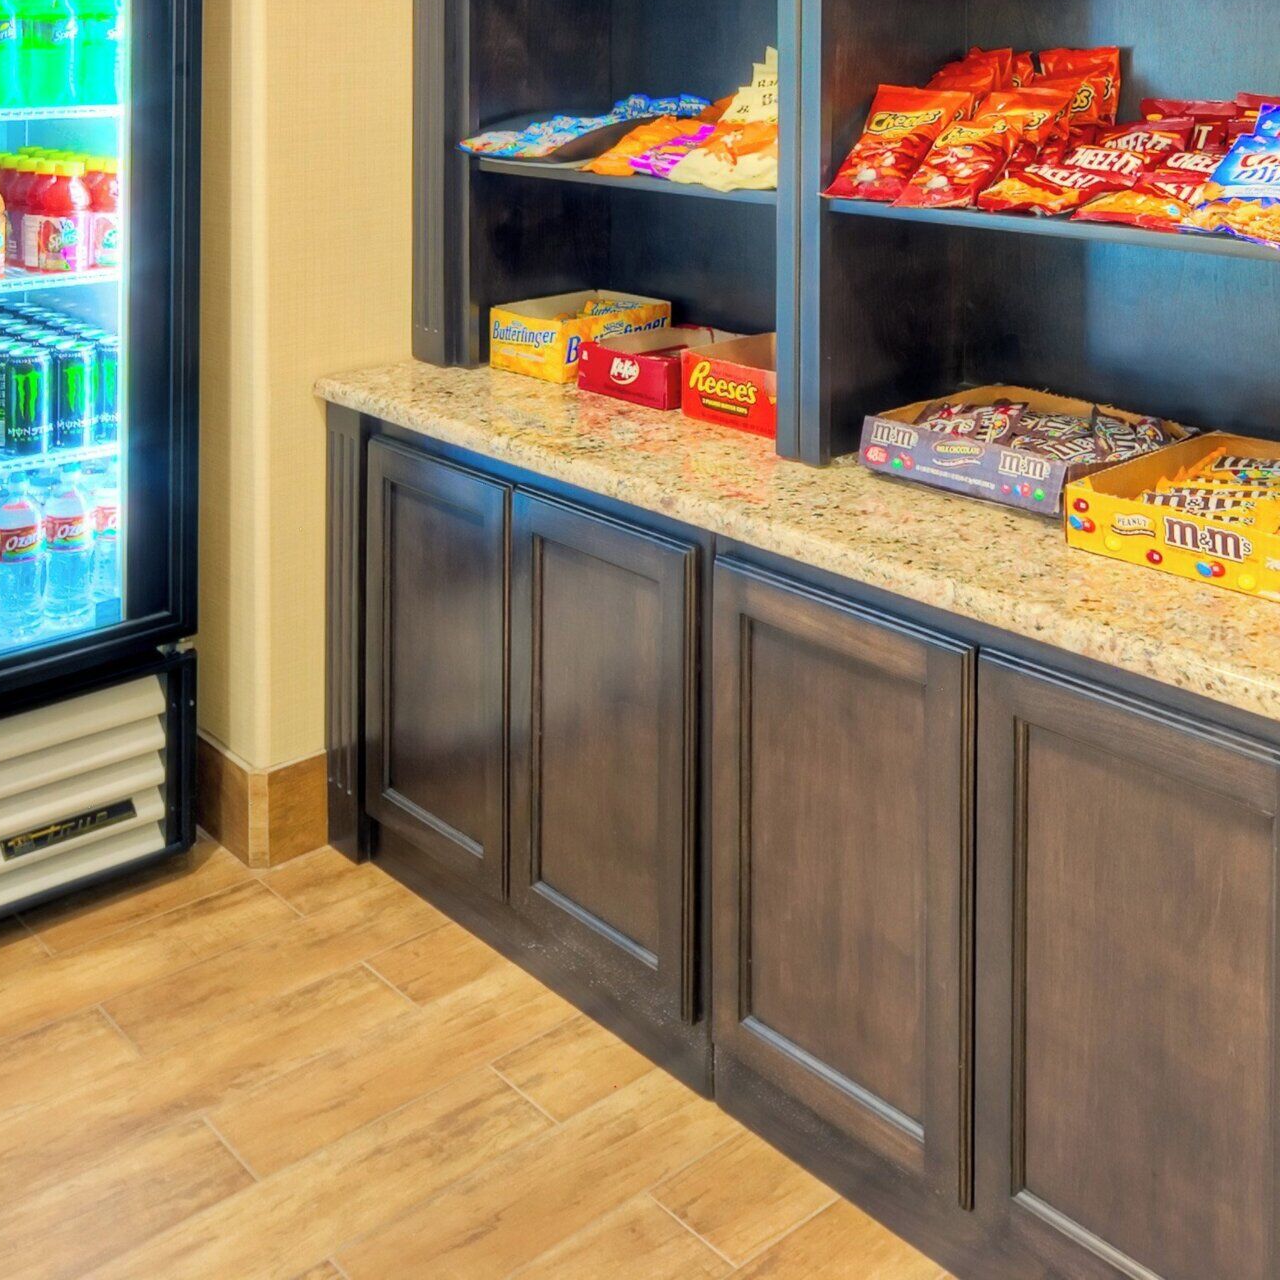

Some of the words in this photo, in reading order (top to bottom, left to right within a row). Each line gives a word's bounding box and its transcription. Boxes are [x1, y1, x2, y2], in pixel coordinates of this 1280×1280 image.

[491, 320, 558, 349] Butterfinger
[688, 360, 758, 405] Reese's
[1116, 515, 1149, 529] PEANUT
[1164, 516, 1253, 563] m&m's
